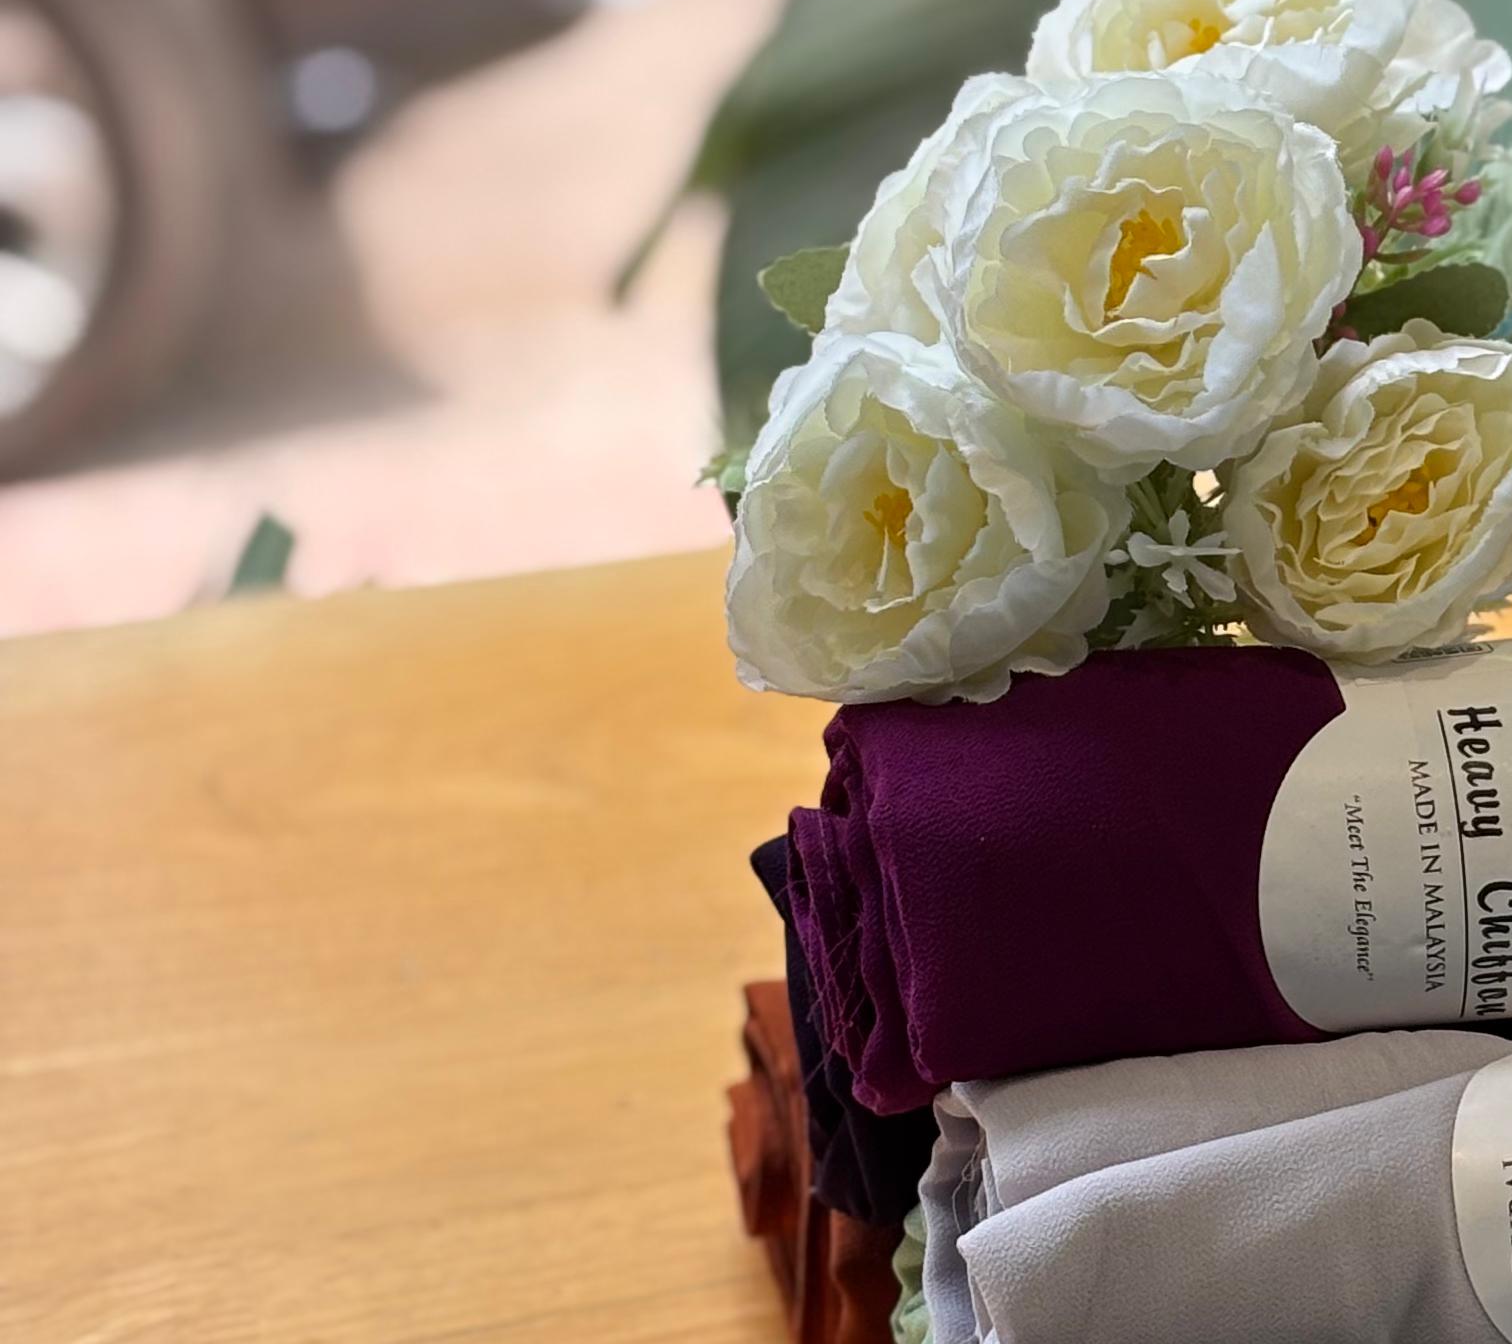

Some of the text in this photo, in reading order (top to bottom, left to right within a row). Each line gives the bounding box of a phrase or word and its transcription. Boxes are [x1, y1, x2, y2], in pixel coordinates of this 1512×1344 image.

[1448, 706, 1503, 838] Heavy
[1351, 857, 1369, 891] The
[1408, 759, 1450, 992] MADE IN MALAYSIA
